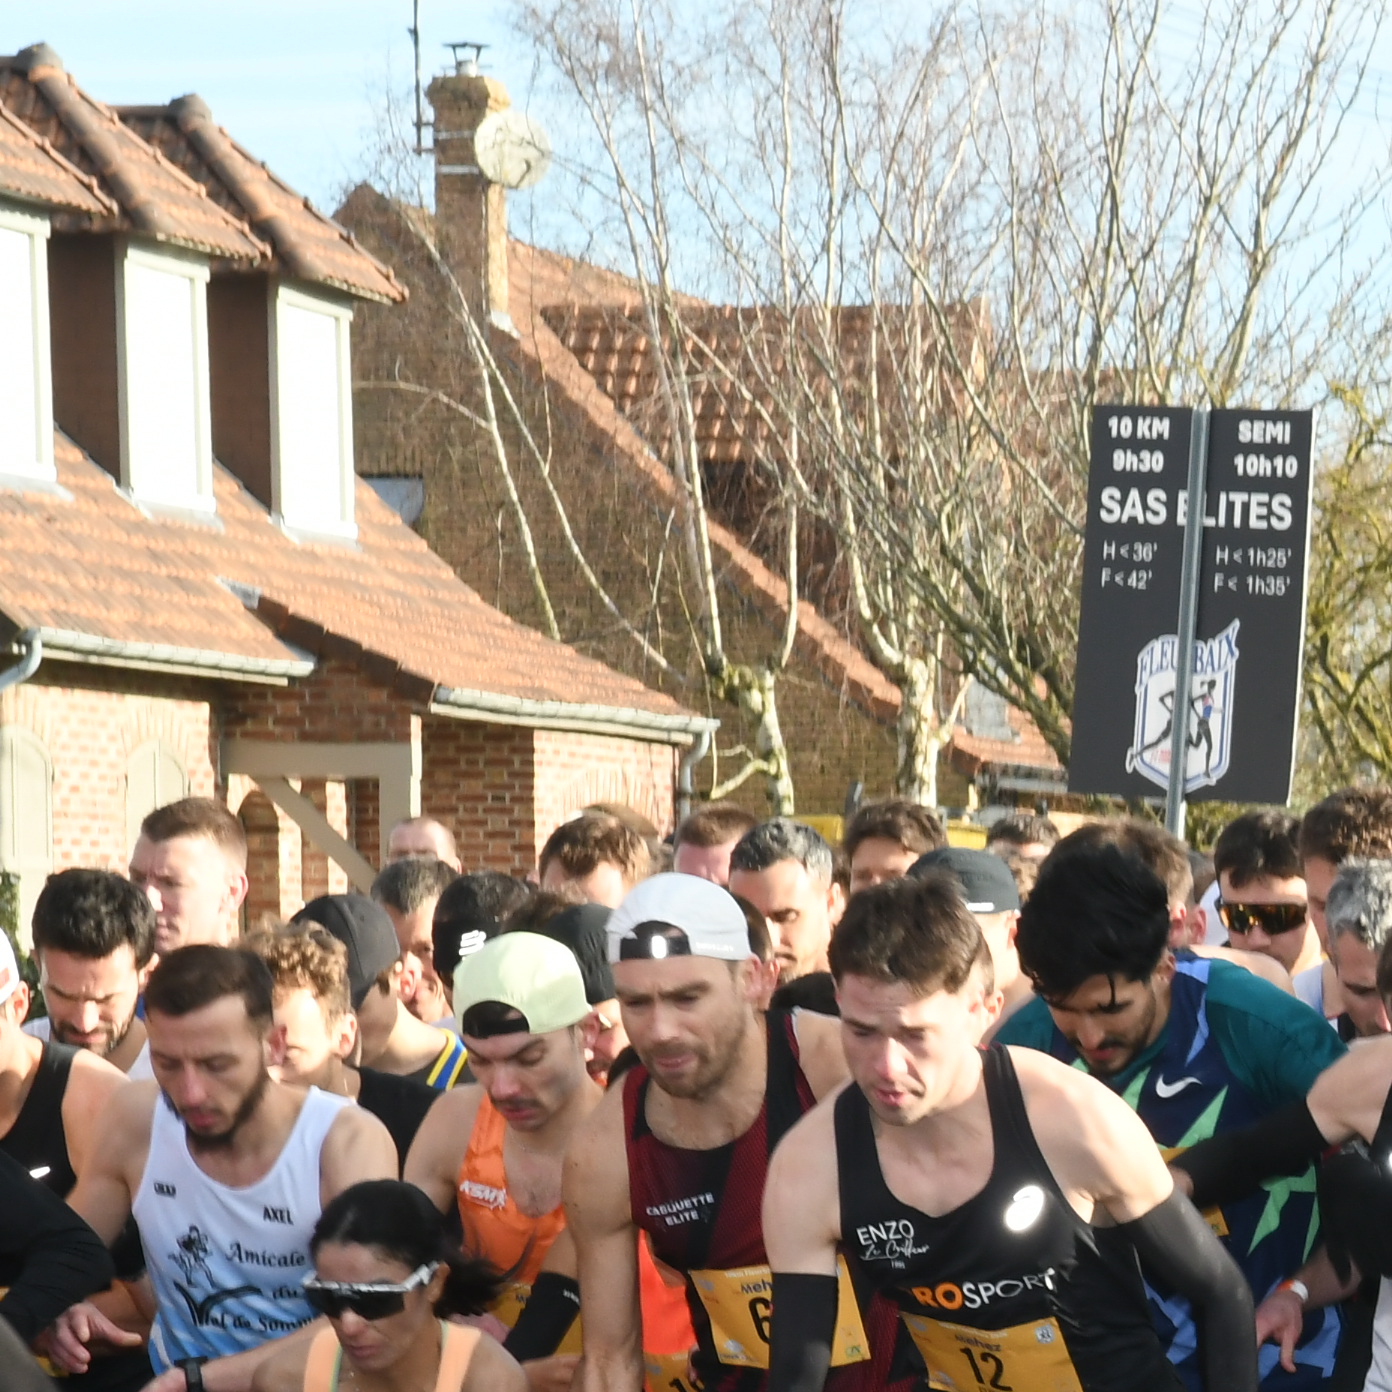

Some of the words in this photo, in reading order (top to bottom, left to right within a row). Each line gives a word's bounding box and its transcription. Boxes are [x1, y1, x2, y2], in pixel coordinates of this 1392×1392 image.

[1108, 416, 1133, 439] 10
[1137, 416, 1170, 440] KM
[1238, 420, 1291, 445] SEMI
[1112, 448, 1165, 473] 9h30
[1234, 453, 1298, 479] 10h10
[1100, 486, 1168, 525] SAS
[1103, 540, 1115, 561] H
[1215, 545, 1229, 566] H
[1101, 568, 1112, 589] F
[1213, 573, 1224, 594] F
[1139, 626, 1239, 680] FLEUBAIX
[263, 1205, 294, 1226] AXEL
[664, 1209, 700, 1227] ELITE
[856, 1218, 915, 1247] ENZO
[225, 1239, 307, 1268] Amicale
[272, 1285, 300, 1300] du
[741, 1279, 772, 1295] Meh
[906, 1267, 1057, 1311] ROSPORT
[959, 1346, 1014, 1392] 12
